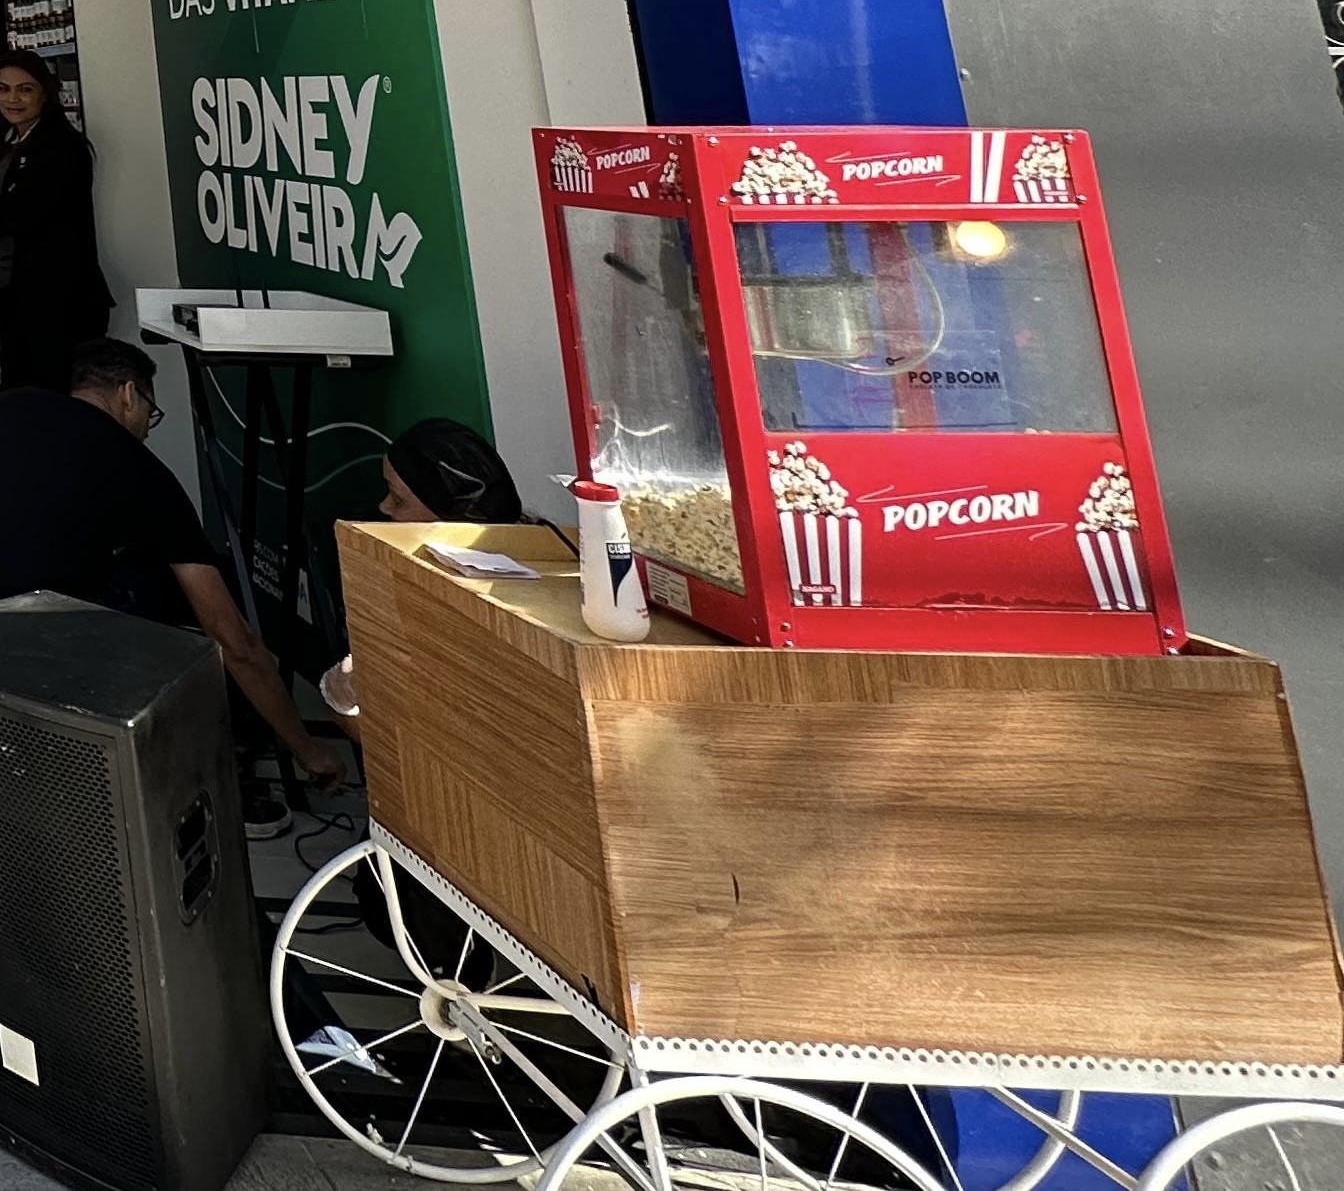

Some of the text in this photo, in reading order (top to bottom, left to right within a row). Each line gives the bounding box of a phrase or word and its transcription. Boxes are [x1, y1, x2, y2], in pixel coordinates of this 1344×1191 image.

[192, 74, 380, 185] SIDNEY
[596, 146, 651, 170] POPCORN
[842, 154, 944, 182] POPCORN
[908, 371, 1001, 384] POP BOOM
[883, 490, 1040, 533] POPCORN
